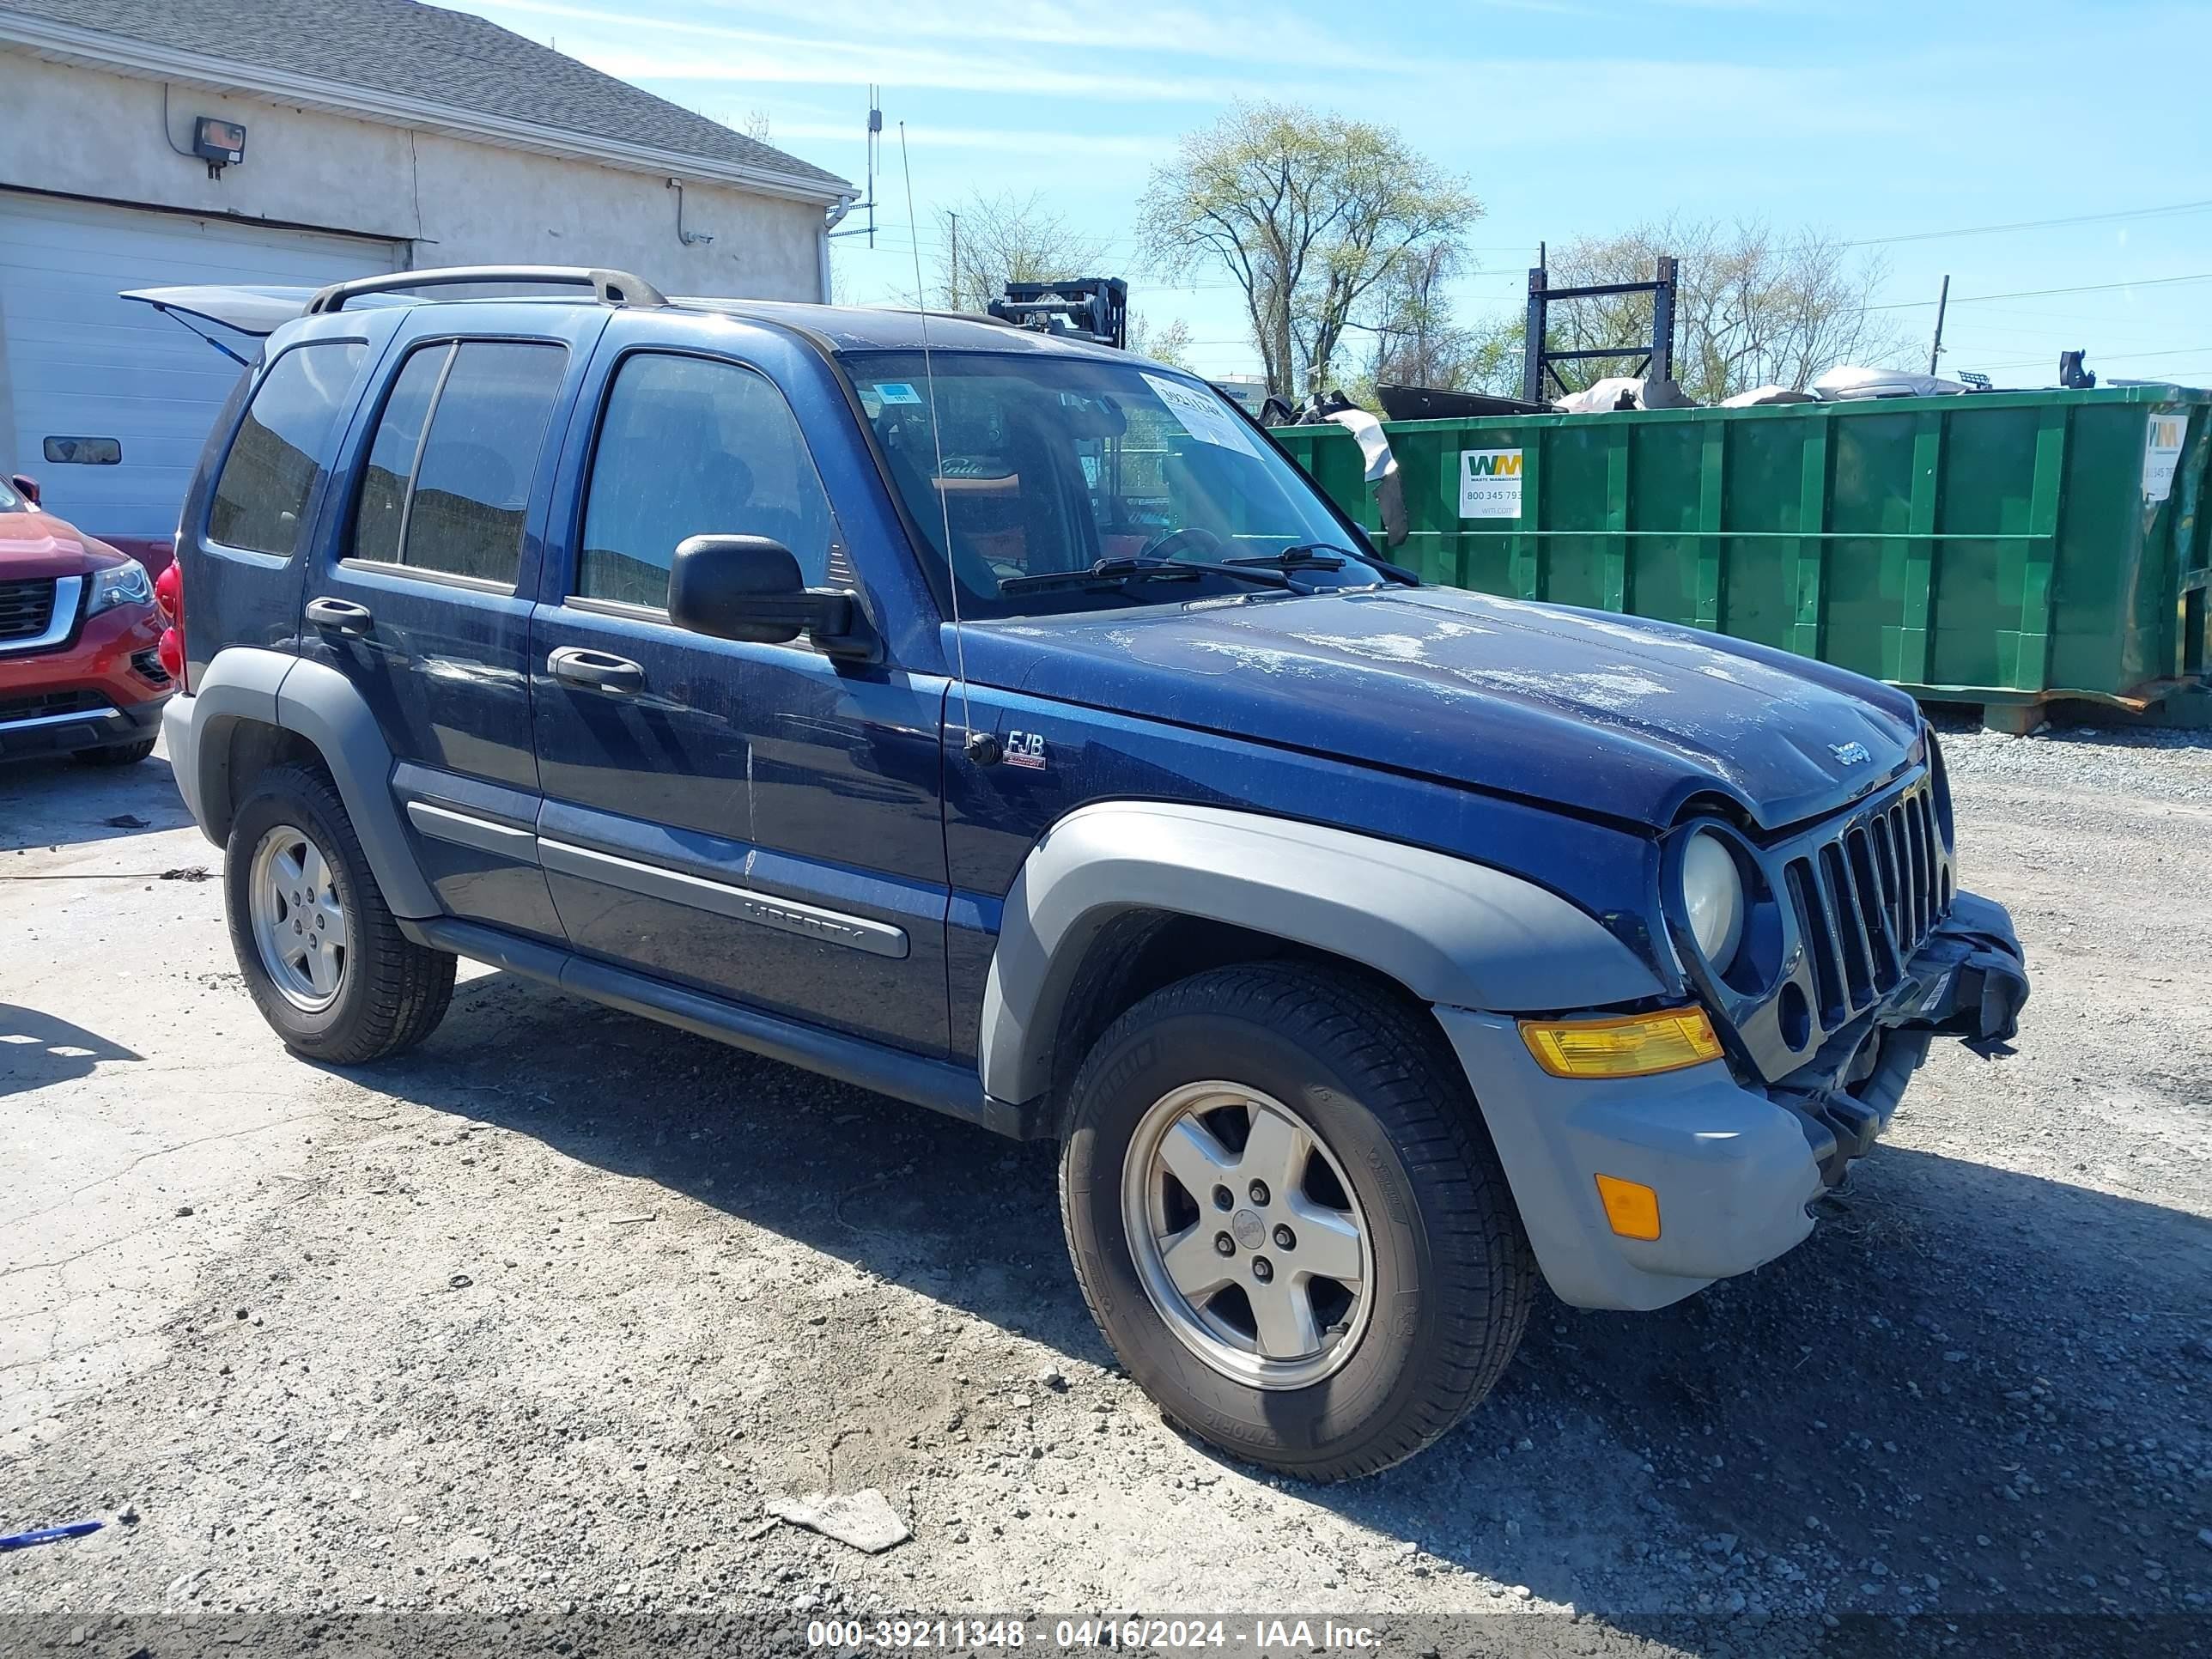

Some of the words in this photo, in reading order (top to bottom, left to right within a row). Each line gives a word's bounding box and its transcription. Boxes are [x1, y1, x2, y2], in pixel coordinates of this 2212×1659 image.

[1468, 455, 1522, 476] WM
[1467, 491, 1485, 500] 800
[1486, 491, 1504, 500] 345
[1008, 730, 1044, 756] FJB
